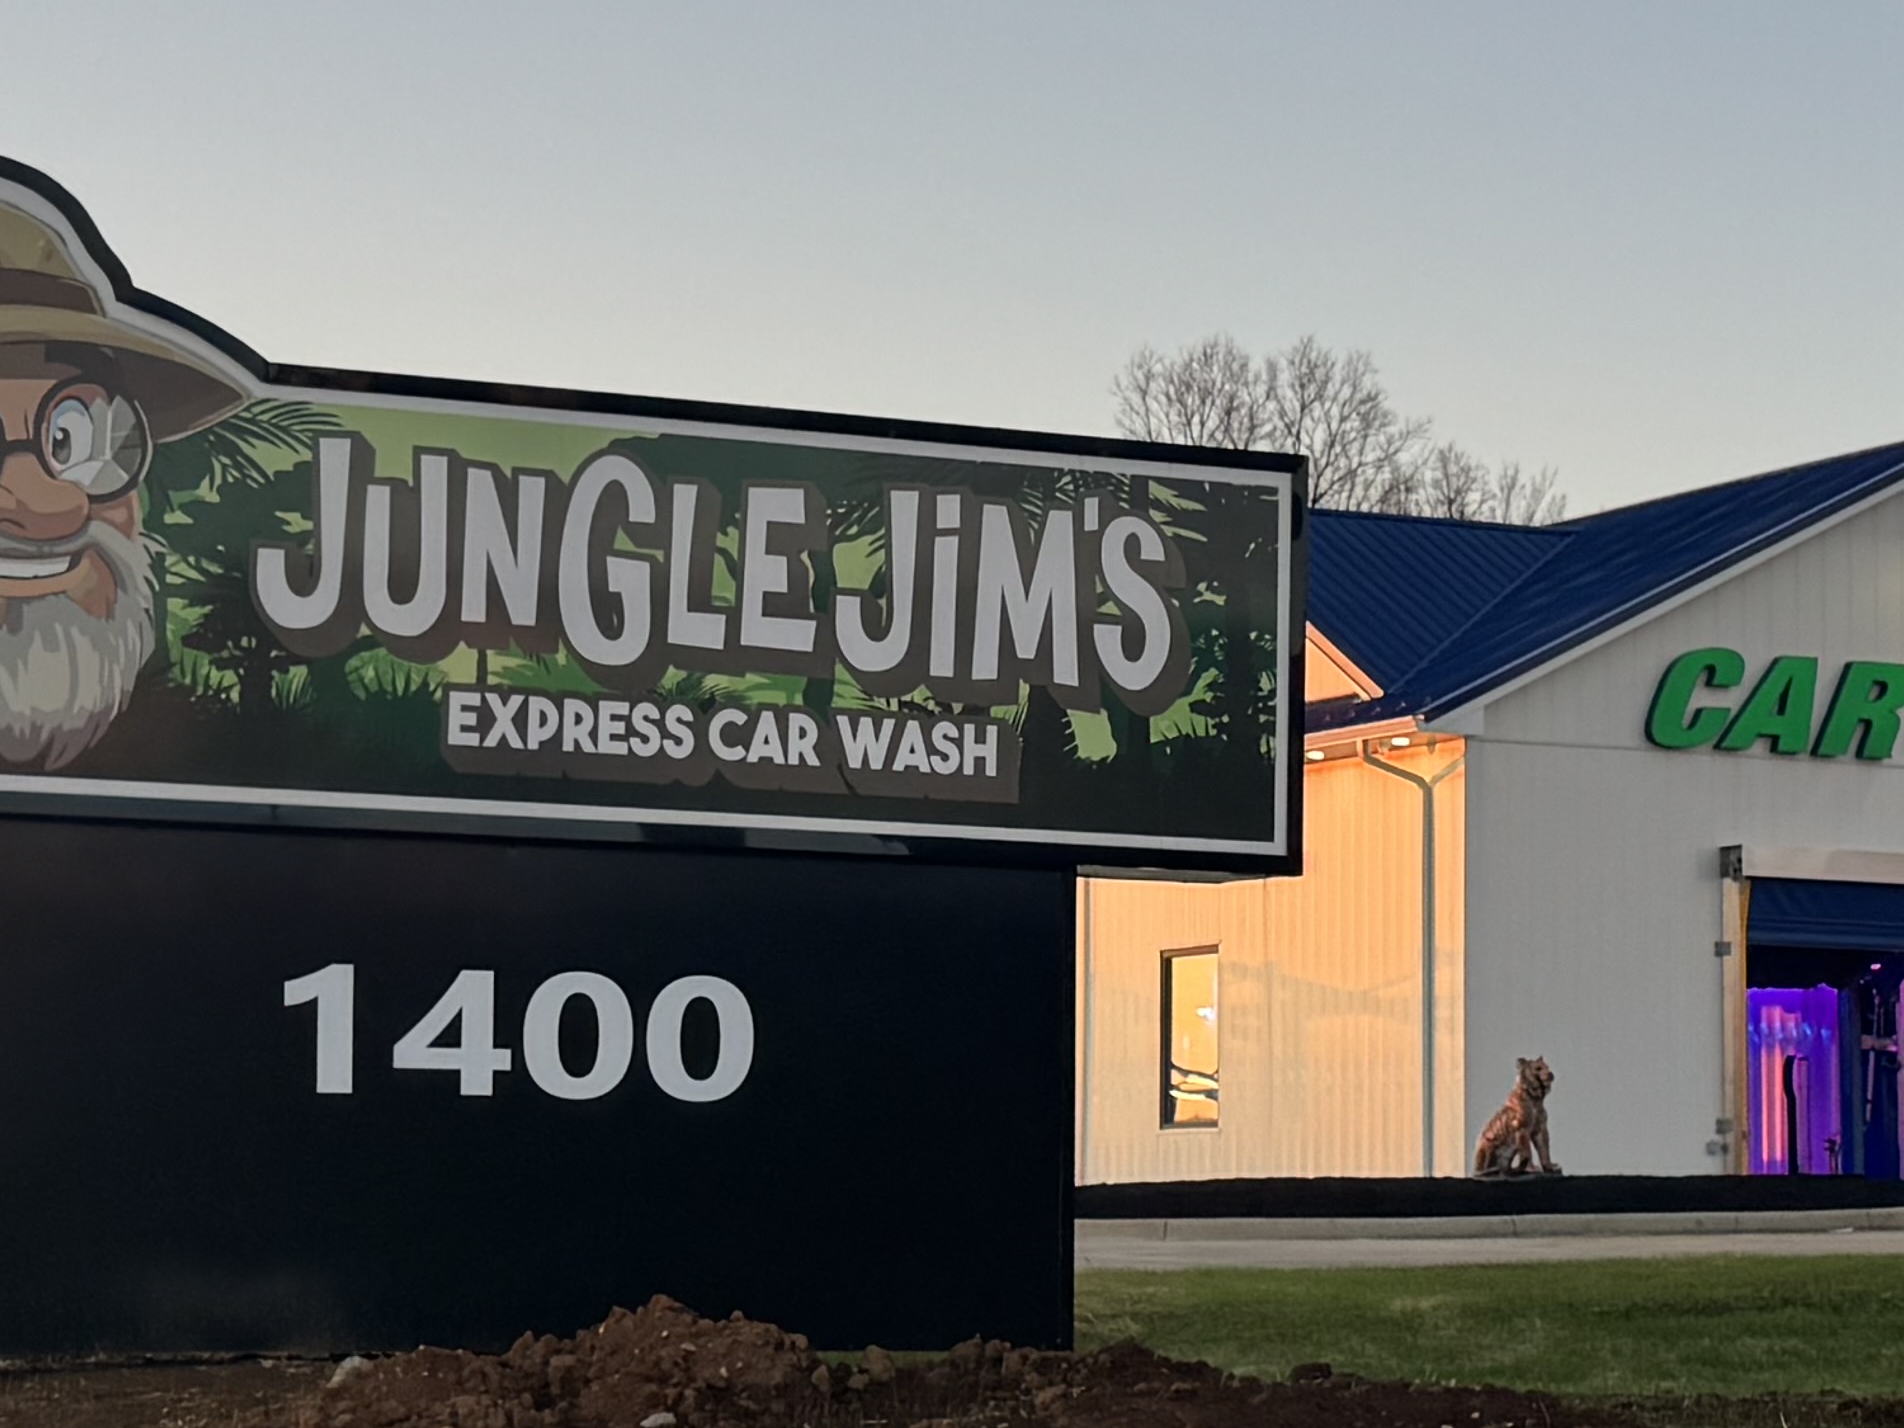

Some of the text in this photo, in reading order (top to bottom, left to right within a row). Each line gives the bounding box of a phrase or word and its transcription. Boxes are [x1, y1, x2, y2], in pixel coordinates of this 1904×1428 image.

[255, 436, 818, 667] JUNGLE
[446, 690, 999, 778] EXPRESS CAR WASH
[283, 962, 755, 1103] 1400
